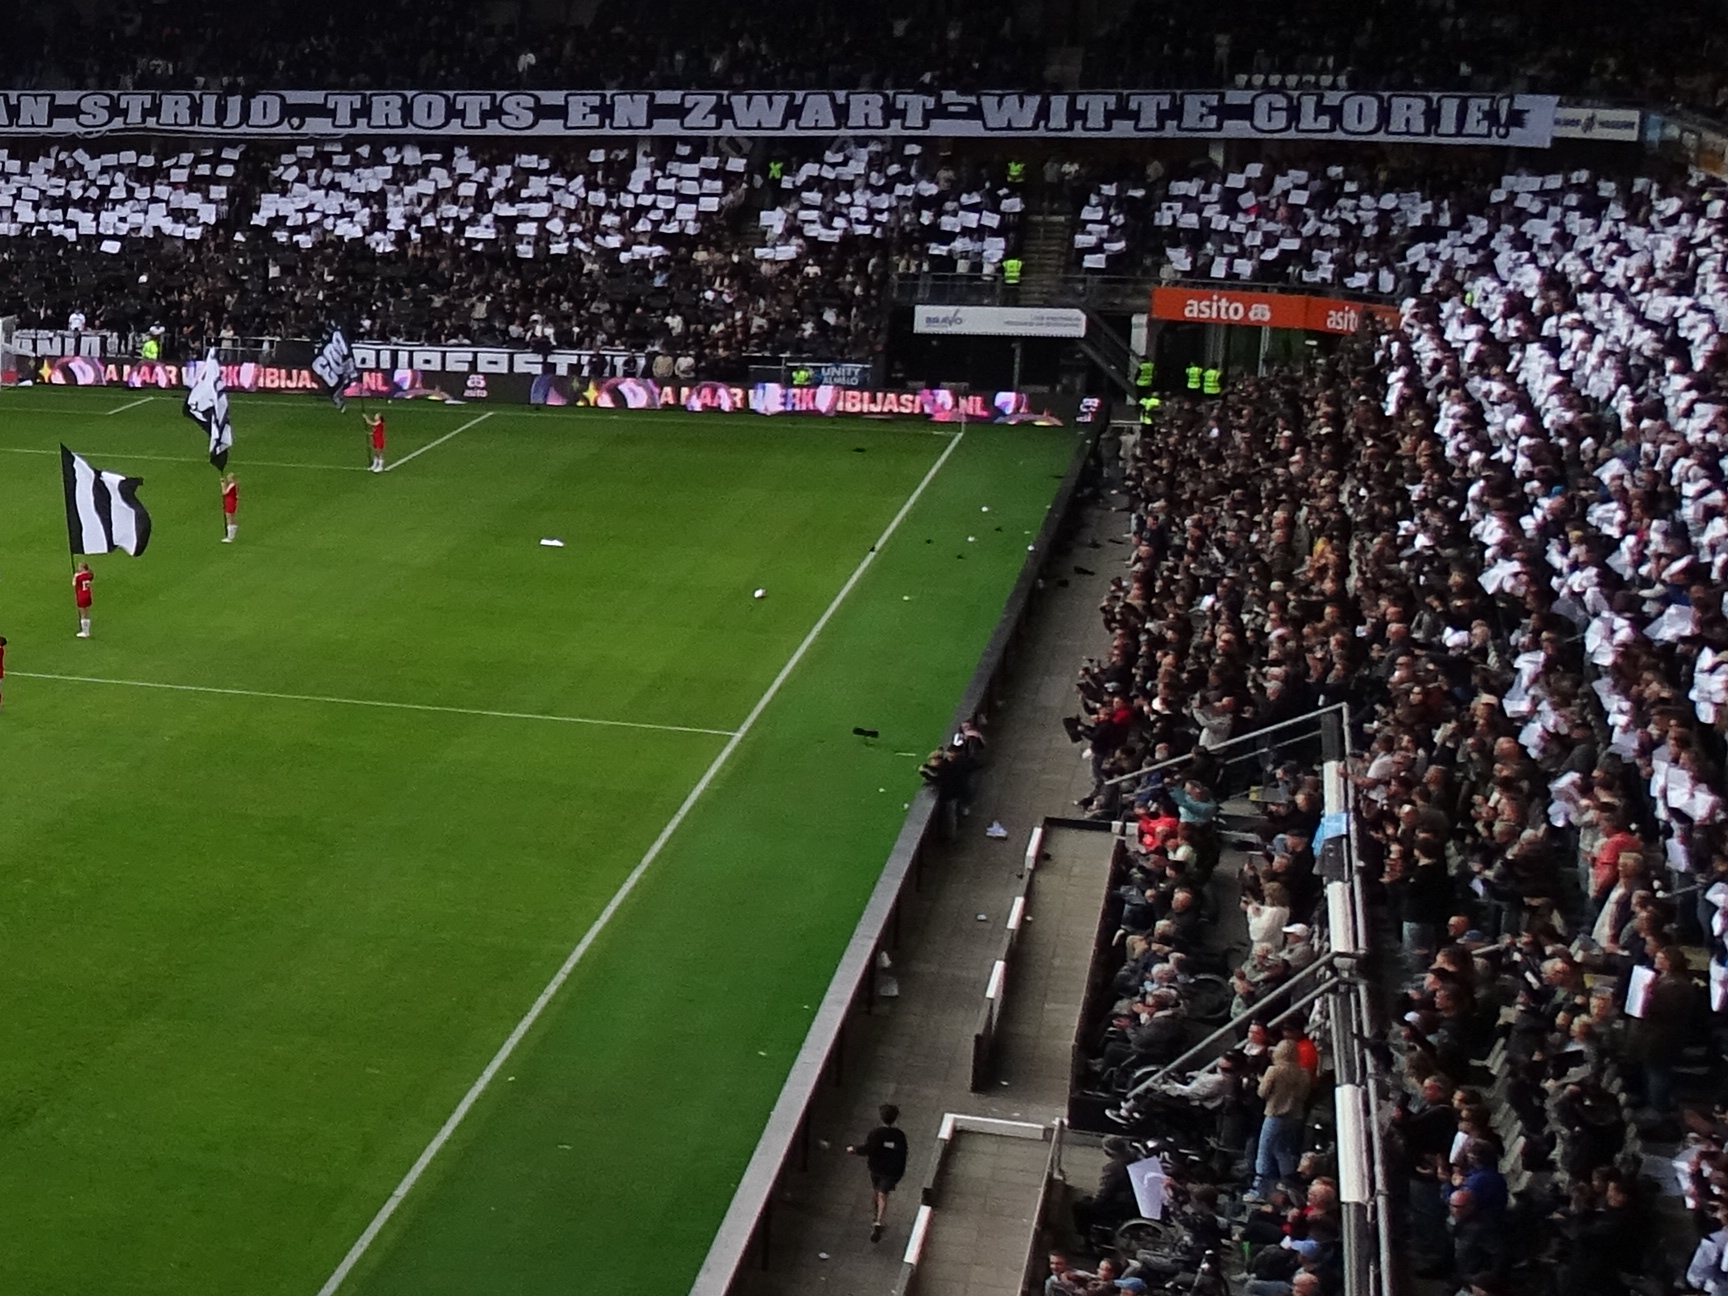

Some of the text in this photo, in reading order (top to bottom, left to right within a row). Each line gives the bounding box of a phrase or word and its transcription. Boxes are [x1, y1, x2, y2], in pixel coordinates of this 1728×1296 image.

[76, 93, 302, 130] STRIJD,
[327, 93, 540, 130] TROTS
[564, 93, 651, 130] EN
[1250, 94, 1514, 138] GLORIE!
[1184, 294, 1244, 321] asito
[821, 367, 861, 377] UNITY
